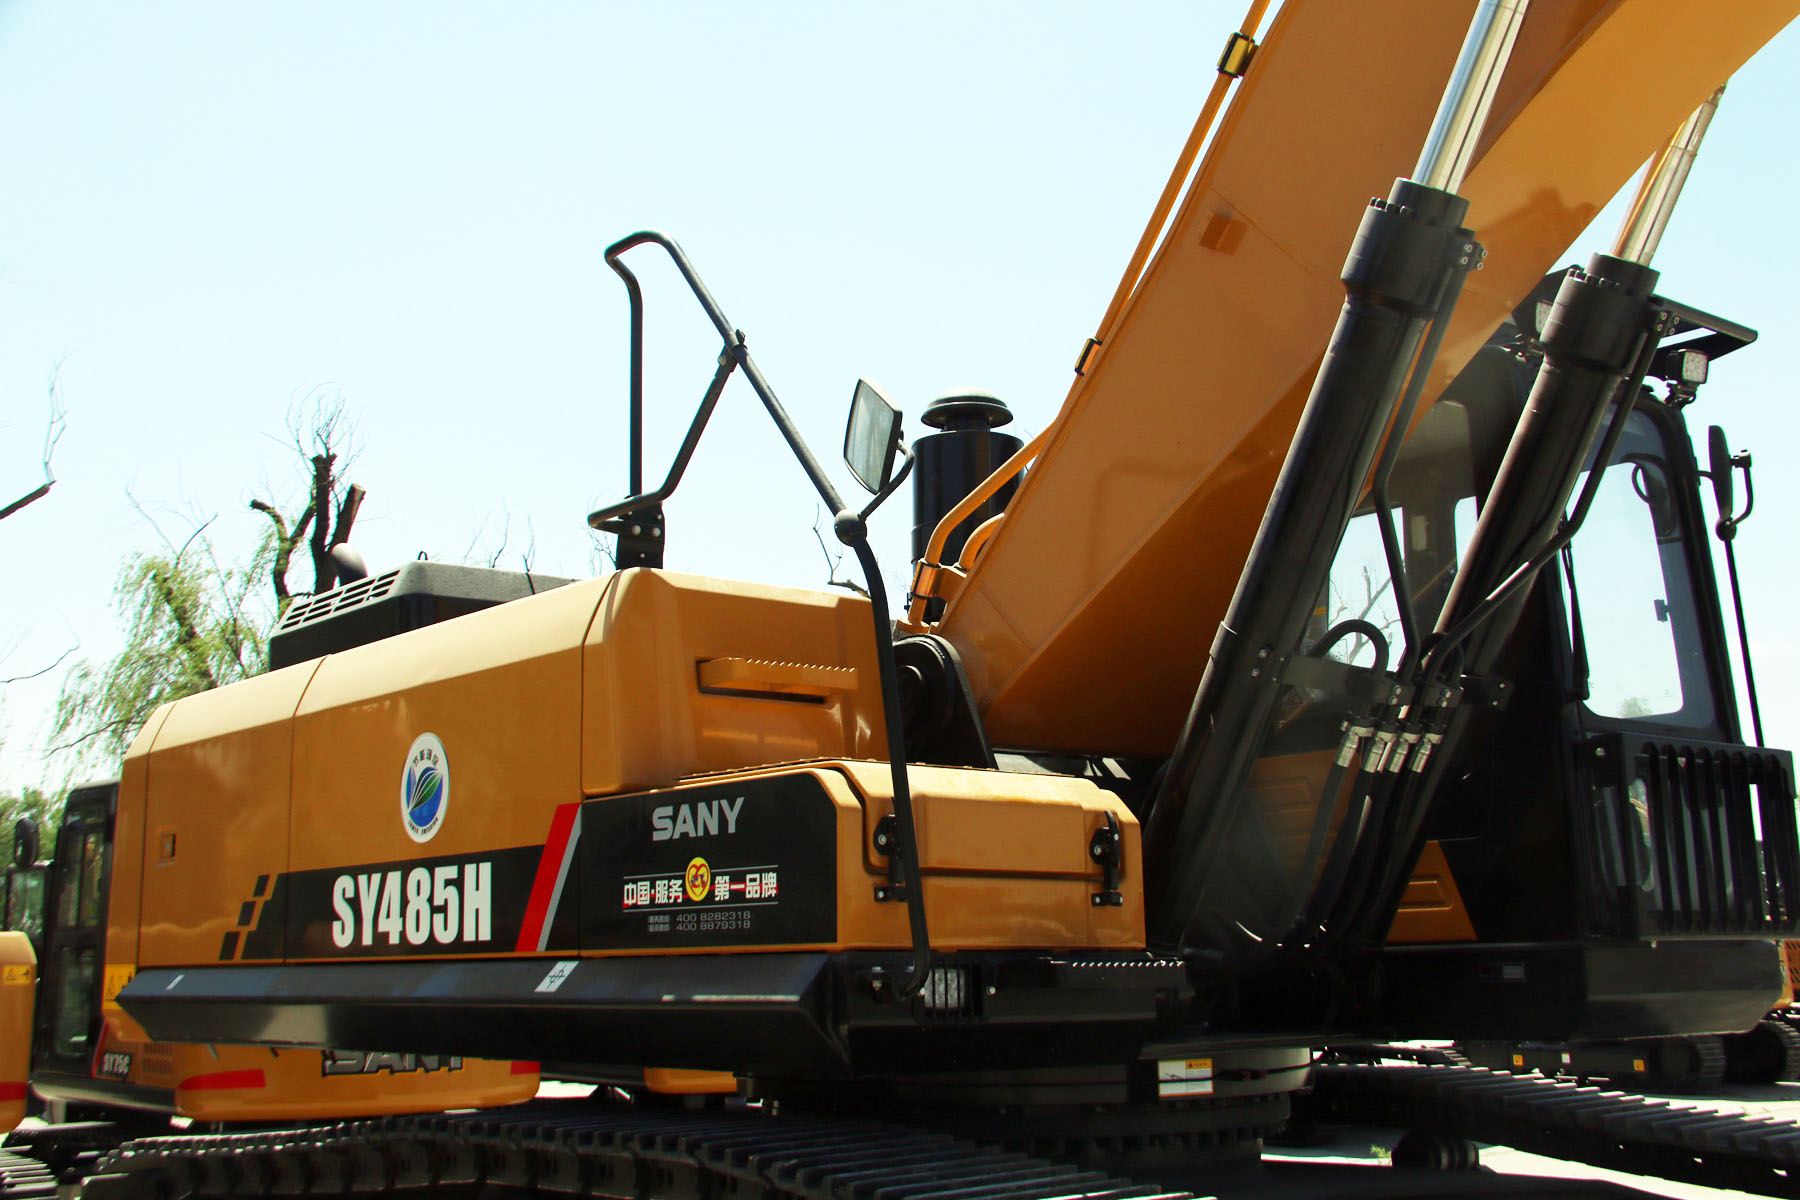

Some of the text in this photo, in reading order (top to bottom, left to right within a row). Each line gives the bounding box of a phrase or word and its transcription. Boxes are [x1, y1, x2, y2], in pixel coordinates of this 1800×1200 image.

[652, 797, 745, 842] SANY
[714, 872, 778, 901] 第一品牌
[331, 861, 492, 949] SY485H
[676, 913, 697, 922] 400
[700, 910, 751, 921] 8282318
[676, 922, 697, 931] 400
[700, 919, 751, 930] 8879318
